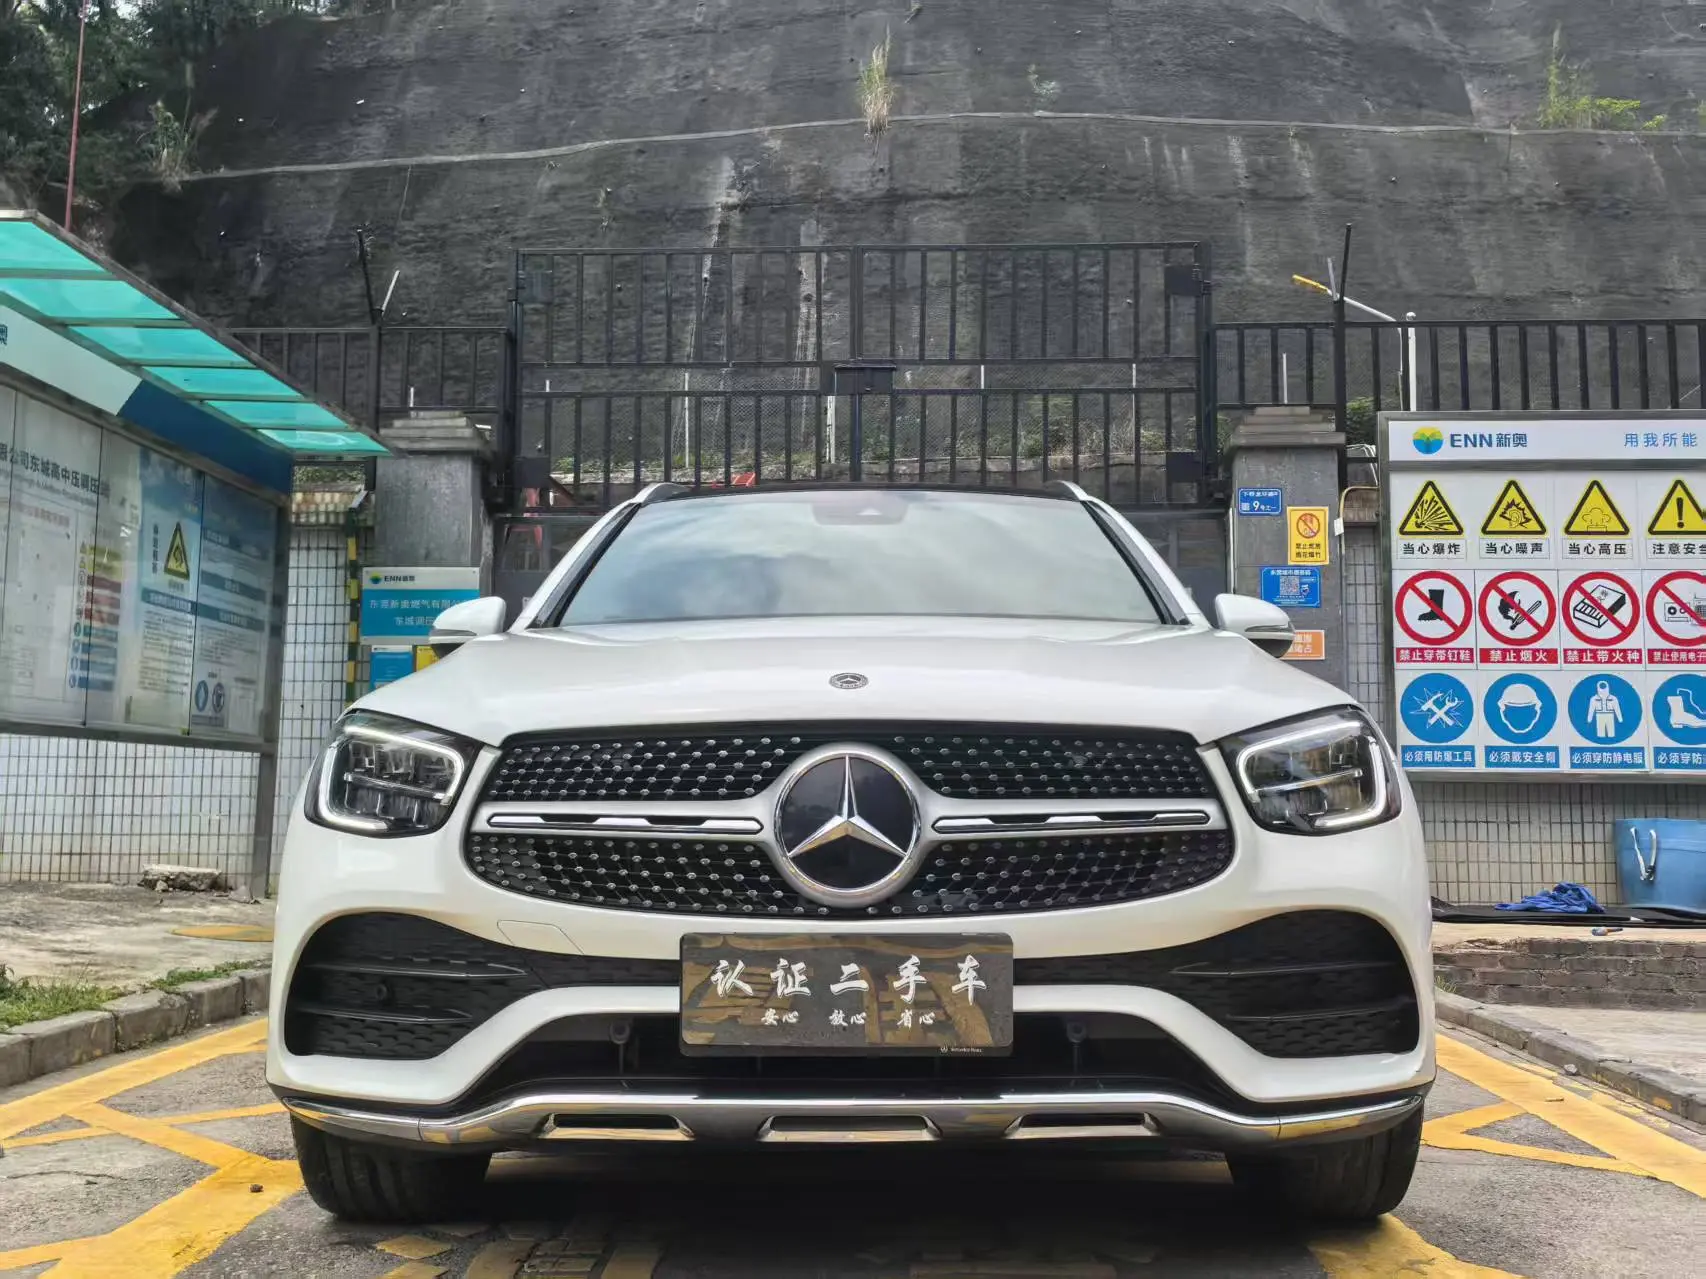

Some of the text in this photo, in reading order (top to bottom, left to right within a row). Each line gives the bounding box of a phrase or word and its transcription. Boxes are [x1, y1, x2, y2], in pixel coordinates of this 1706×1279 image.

[1450, 432, 1528, 448] ENN新奥
[1624, 432, 1698, 448] 用我所能
[1403, 543, 1461, 554] 当心爆炸
[1485, 543, 1543, 554] 当心噪声
[1568, 543, 1627, 555] 当心高压
[1400, 649, 1471, 661] 禁止穿带钉鞋
[1489, 650, 1547, 662] 禁止烟火
[1566, 650, 1640, 662] 禁止带火种
[1488, 751, 1556, 763] 必须戴安全帽
[1572, 752, 1643, 764] 必须穿防静电服
[1657, 752, 1706, 764] 必须穿防
[710, 954, 987, 1006] 认证二手车
[760, 1008, 936, 1029] 安心 放心 省心
